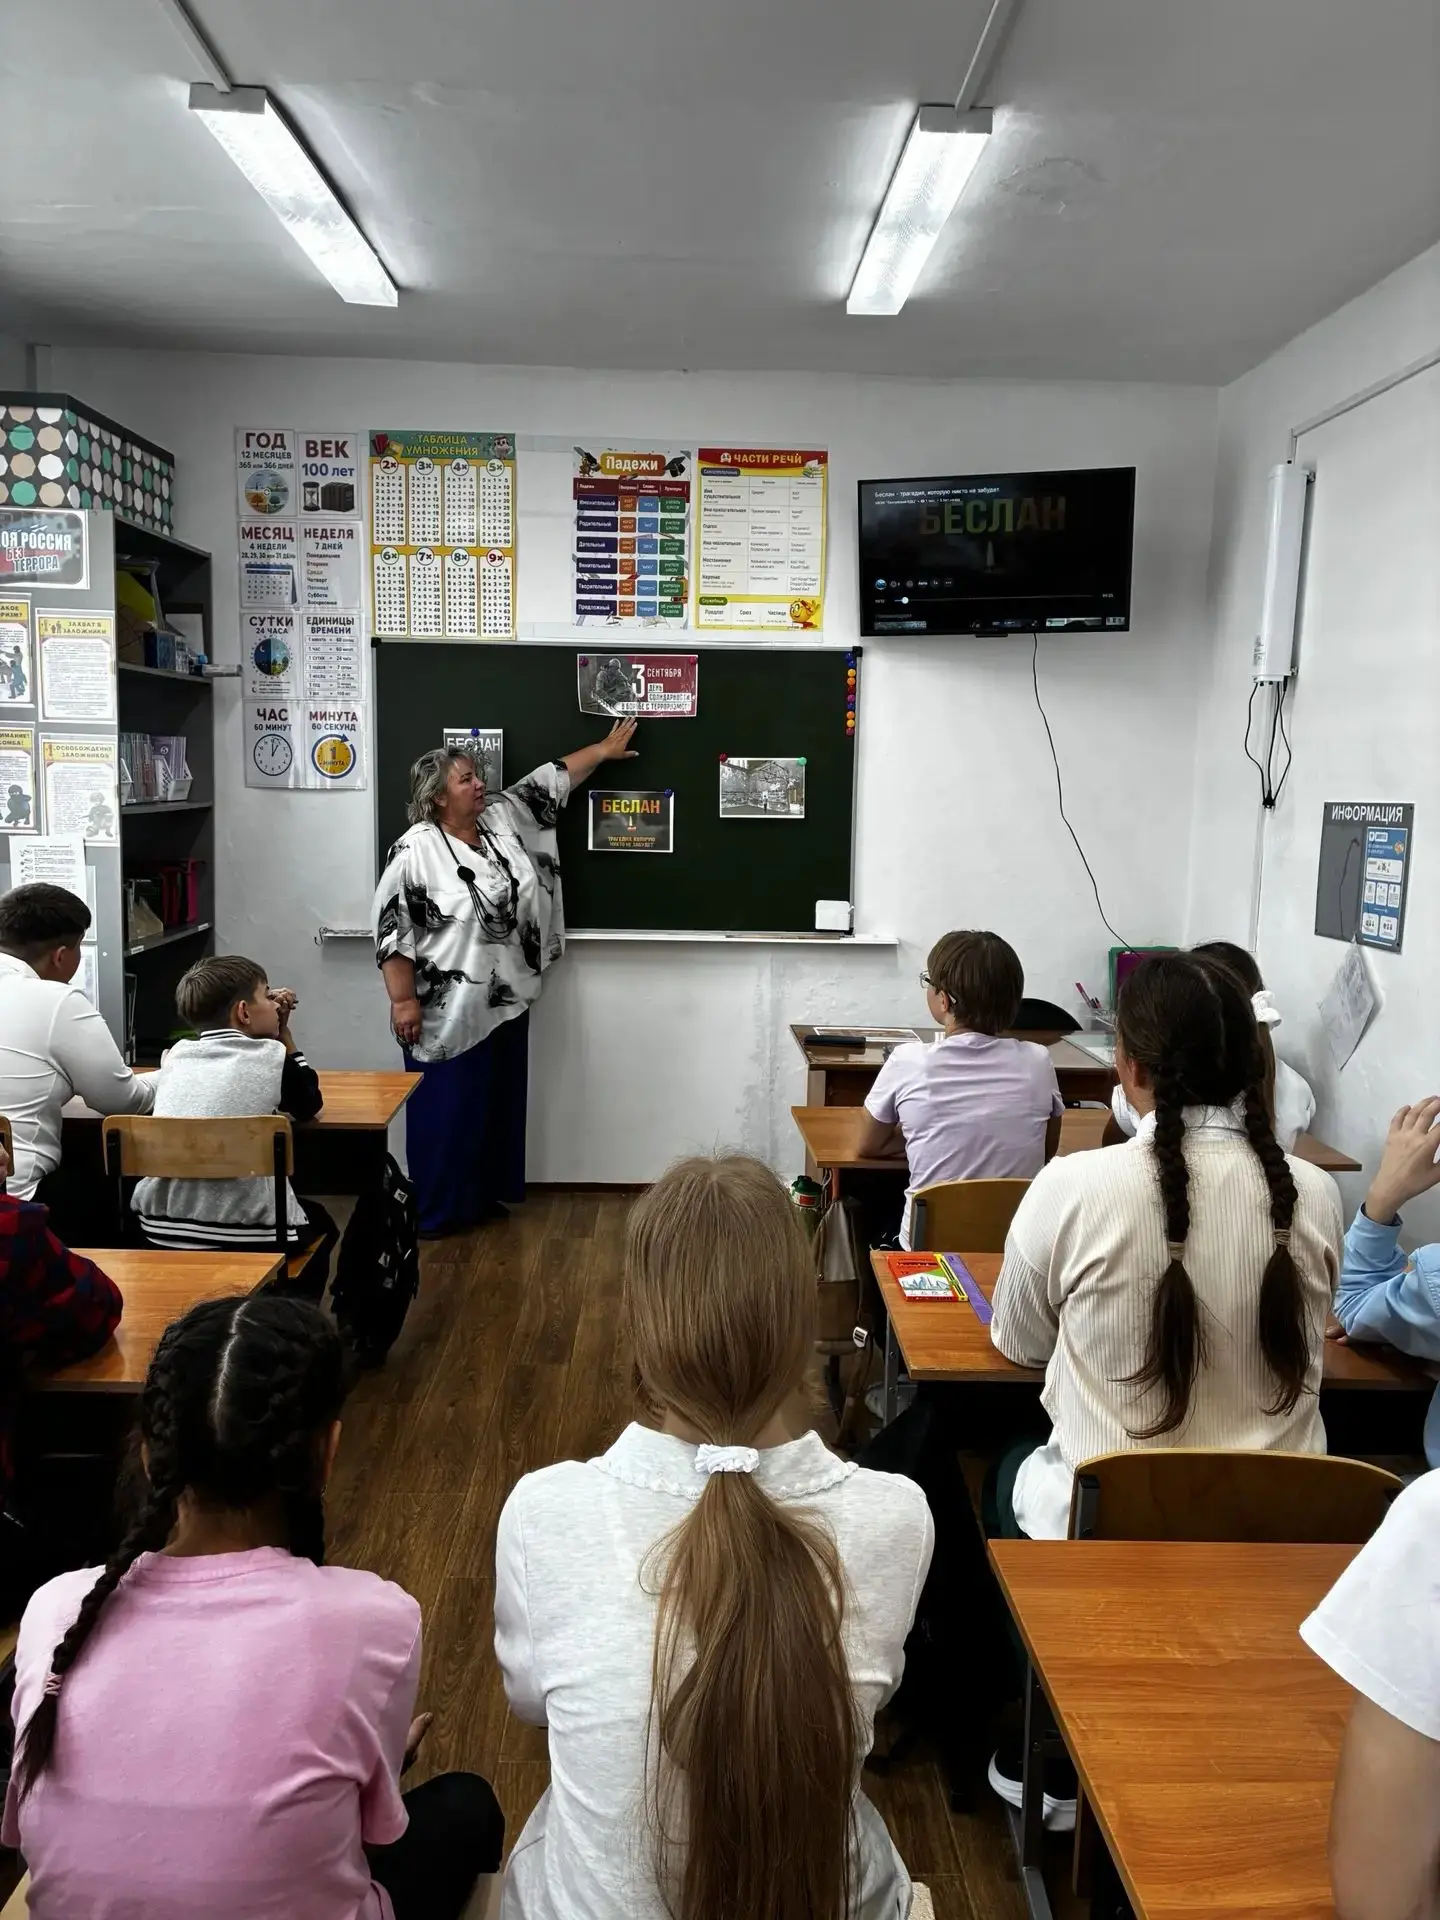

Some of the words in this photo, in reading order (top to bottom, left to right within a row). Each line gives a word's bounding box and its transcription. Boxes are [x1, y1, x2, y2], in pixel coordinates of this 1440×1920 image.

[246, 432, 287, 451] ГОД
[419, 434, 468, 445] ТАБЛИЦА
[305, 439, 350, 459] ВЕК
[406, 446, 478, 456] УМНОЖЕНИЯ
[241, 451, 251, 460] 12
[253, 451, 292, 460] МЕСЯЦЕВ
[734, 453, 770, 463] ЧАСТИ
[773, 453, 802, 464] РЕЧИ
[239, 461, 251, 469] 365
[264, 461, 277, 470] 366
[302, 463, 329, 476] 100
[331, 467, 355, 477] лет
[606, 456, 659, 473] Падежи
[875, 490, 896, 498] Беслан
[900, 490, 926, 498] трагедия,
[927, 489, 950, 497] которую
[977, 486, 1000, 494] забудет
[921, 497, 1066, 535] БЕСЛАН
[241, 526, 295, 543] МЕСЯЦ
[304, 528, 354, 540] НЕДЕЛЯ
[0, 531, 18, 548] ОЯ
[21, 532, 72, 551] РОССИЯ
[321, 541, 343, 551] ДНЕЙ
[257, 543, 287, 551] НЕДЕЛИ
[6, 547, 25, 561] БЕЗ
[14, 555, 60, 573] ТЕРРОРА
[578, 603, 611, 611] Предложный
[249, 615, 294, 627] СУТКИ
[306, 616, 354, 627] ЕДИНИЦЫ
[267, 627, 289, 635] ЧАСА
[311, 626, 351, 635] ВРЕМЕНИ
[631, 664, 646, 698] 3
[647, 668, 683, 679] СЕНТЯБРЯ
[649, 684, 663, 692] ДЕНЬ
[649, 693, 691, 702] СОЛИДАРНОСТИ
[257, 708, 288, 722] ЧАС
[309, 711, 358, 722] МИНУТА
[254, 723, 264, 731] 60
[265, 723, 292, 731] МИНУТ
[311, 723, 322, 731] 60
[324, 723, 356, 732] СЕКУНД
[56, 744, 112, 752] ОСВОБОЖДЕНИЕ
[61, 751, 110, 759] ЗАЛОЖНИКОВ
[602, 799, 661, 814] БЕСЛАН
[1332, 805, 1403, 825] ИНФОРМАЦИЯ
